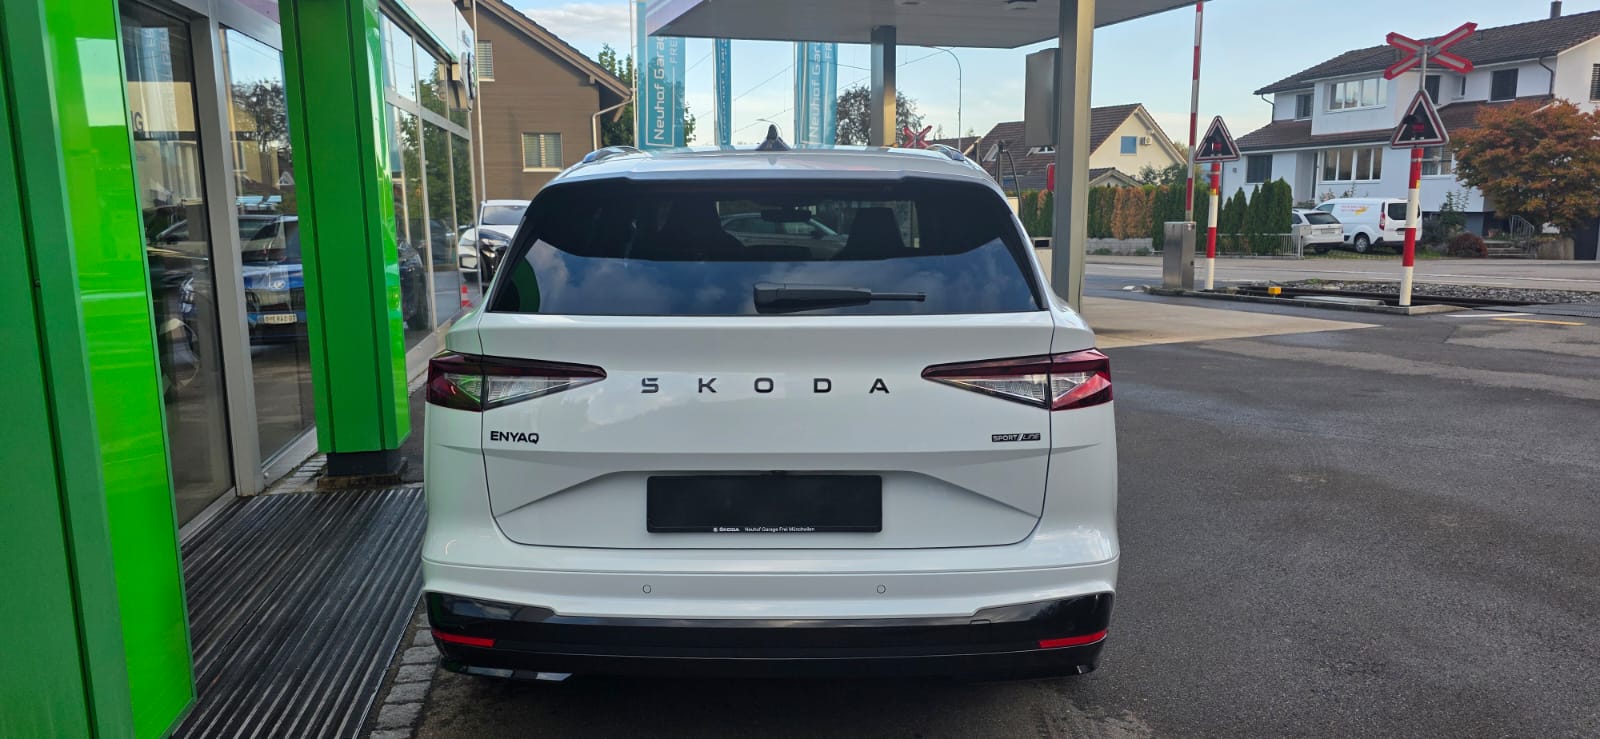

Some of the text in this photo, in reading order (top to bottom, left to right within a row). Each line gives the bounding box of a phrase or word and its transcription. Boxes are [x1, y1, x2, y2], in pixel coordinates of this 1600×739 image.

[653, 83, 665, 140] Neuhof
[809, 81, 821, 139] Neuhof
[490, 430, 540, 444] ENYAQ
